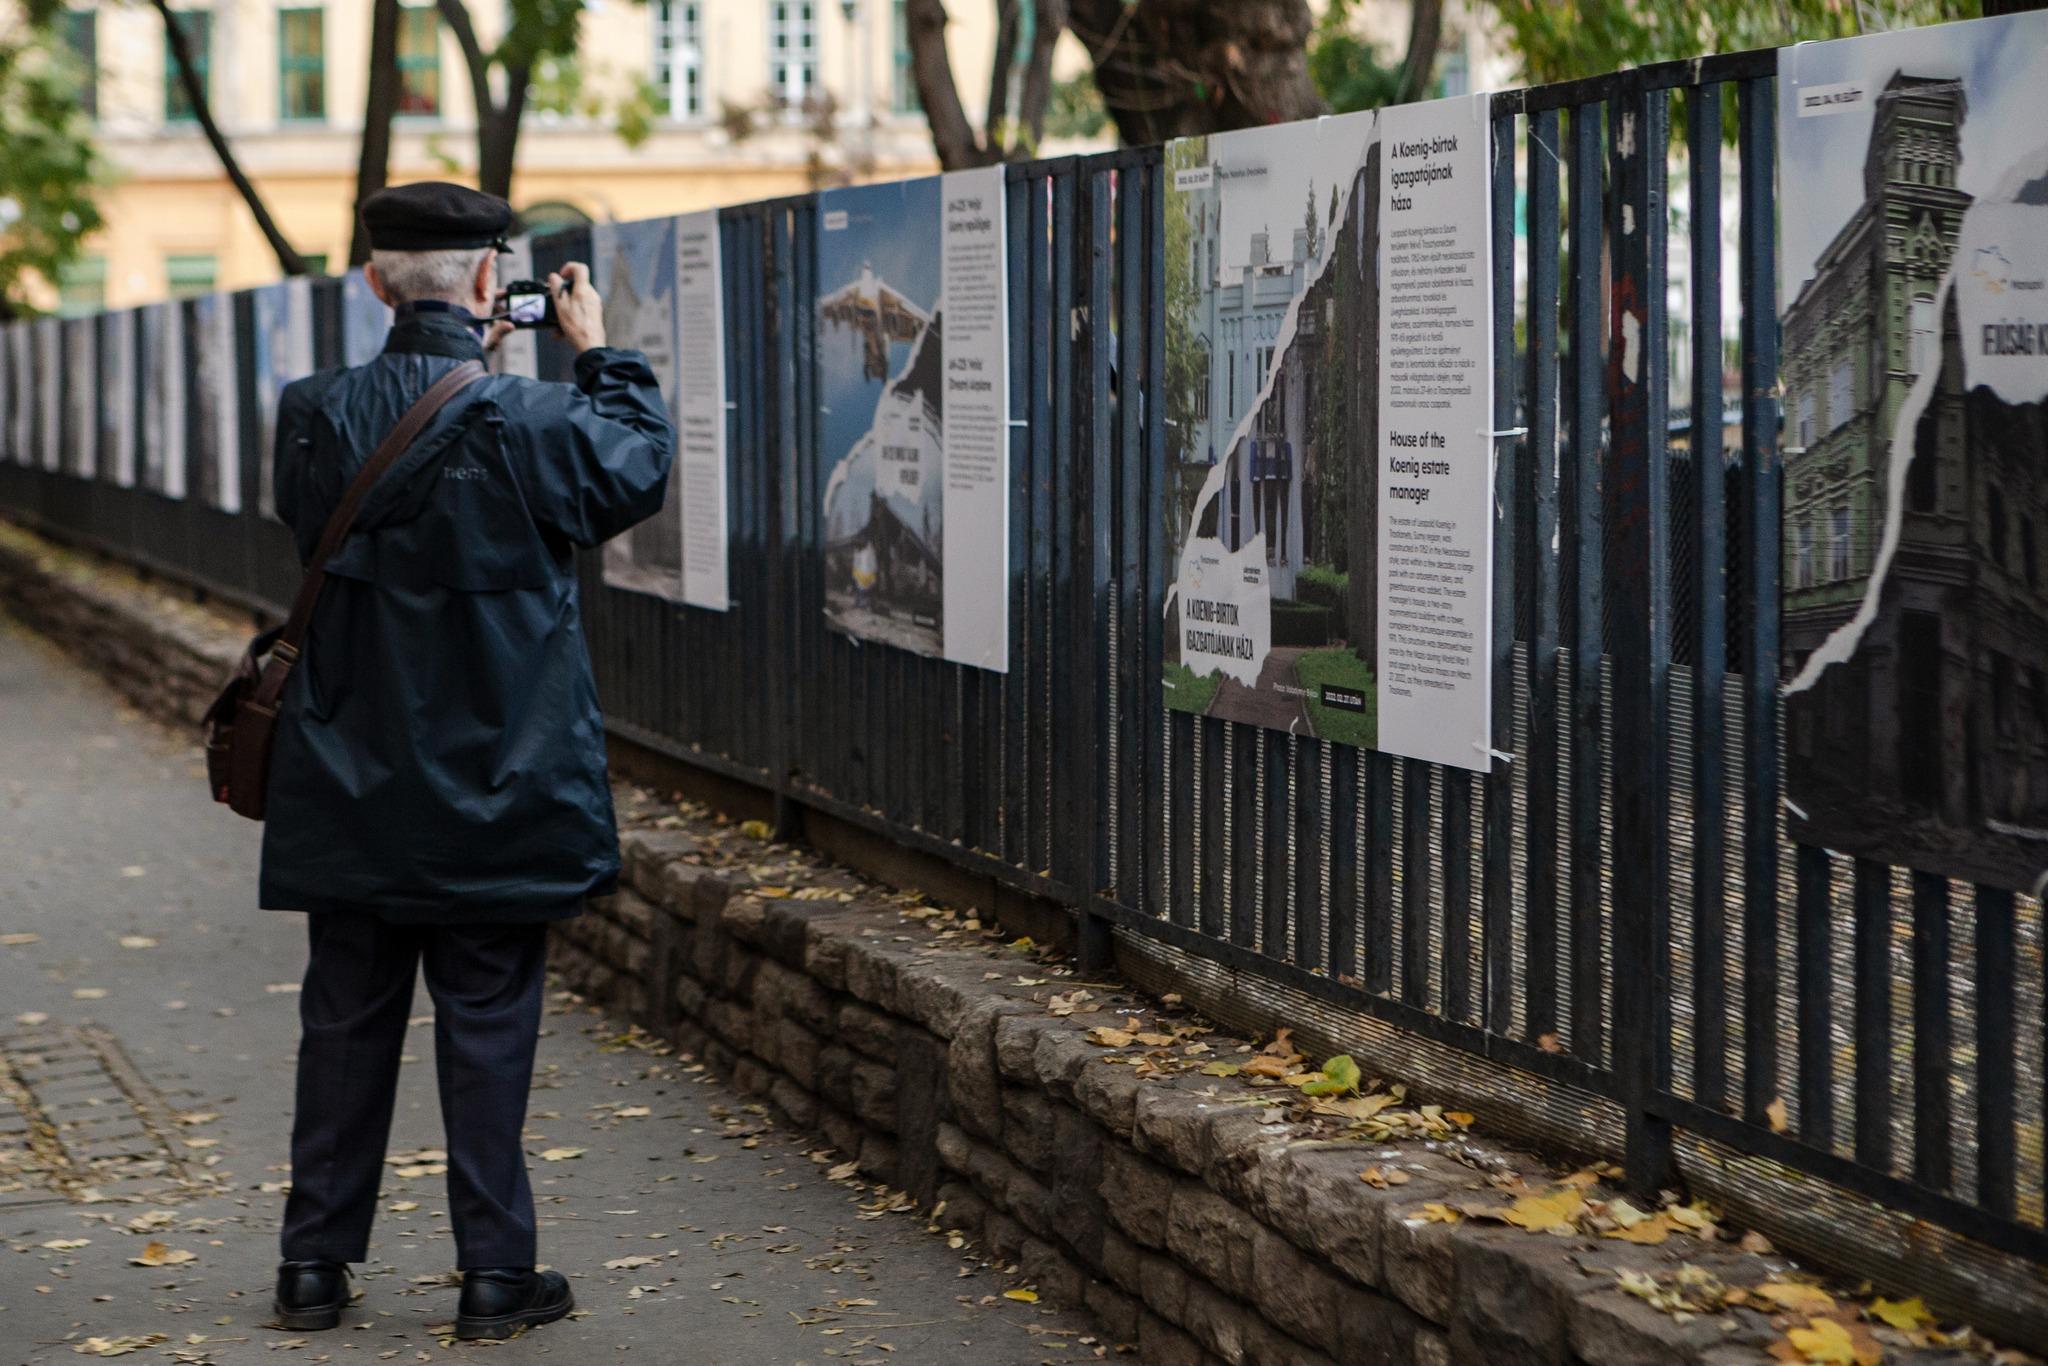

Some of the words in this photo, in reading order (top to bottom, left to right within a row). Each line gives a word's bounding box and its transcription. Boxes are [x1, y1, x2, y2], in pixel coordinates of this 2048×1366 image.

[1392, 142, 1398, 158] A
[1399, 136, 1458, 160] Koenig-birtok
[1391, 164, 1453, 190] igazgatójának
[1391, 194, 1412, 212] háza
[1390, 431, 1417, 447] House
[1419, 432, 1428, 447] of
[1431, 432, 1445, 448] the
[1390, 456, 1419, 478] Koenig
[1422, 461, 1450, 475] estate
[1390, 486, 1430, 504] manager
[1186, 598, 1190, 620] A
[1192, 600, 1239, 626] KOENIG-BIRTOK
[1186, 629, 1235, 657] IGAZGATÓJÁNAK
[1236, 634, 1254, 660] HÁZA
